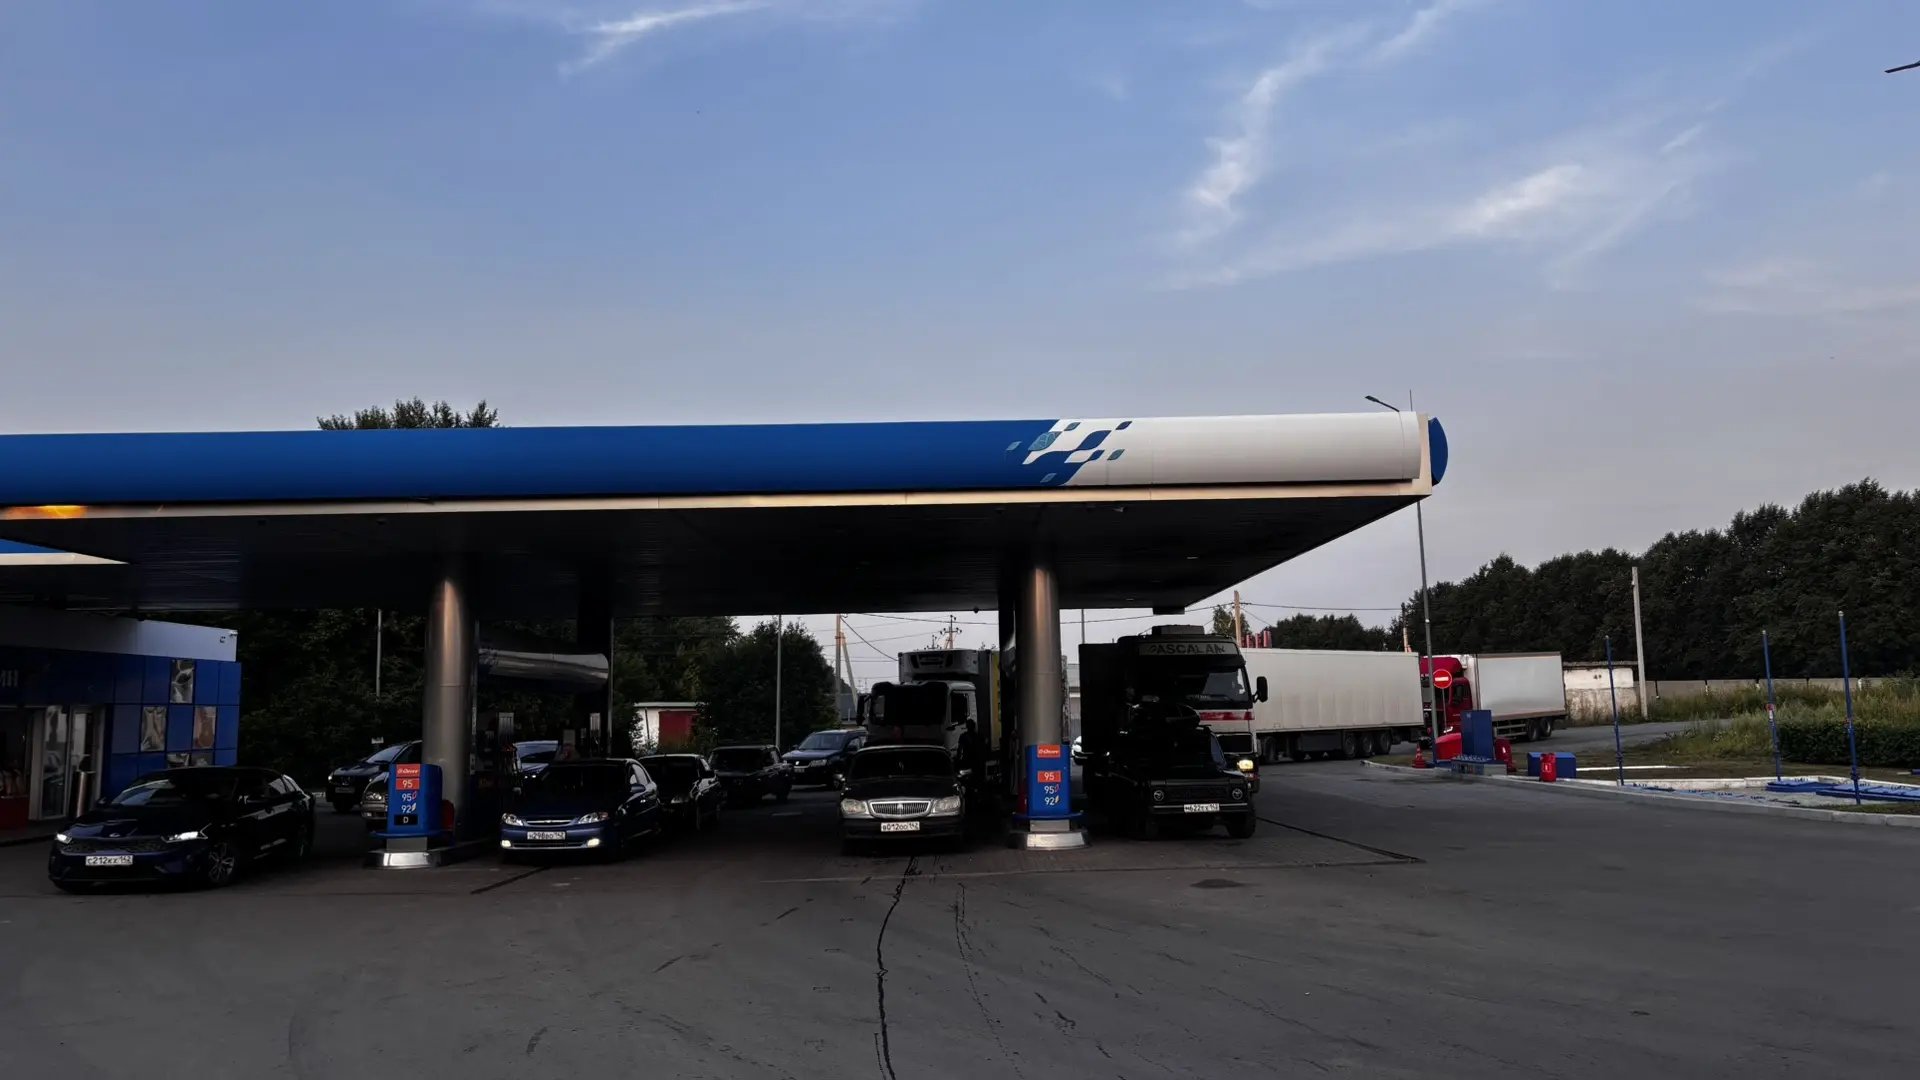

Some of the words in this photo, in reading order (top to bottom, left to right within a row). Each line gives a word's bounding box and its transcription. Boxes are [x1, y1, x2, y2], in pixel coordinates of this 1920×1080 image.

[1043, 772, 1055, 781] 95
[402, 779, 413, 788] 95
[1043, 785, 1055, 794] 95
[401, 793, 412, 802] 95
[1044, 797, 1055, 806] 92
[401, 804, 412, 814] 92
[403, 816, 409, 824] D
